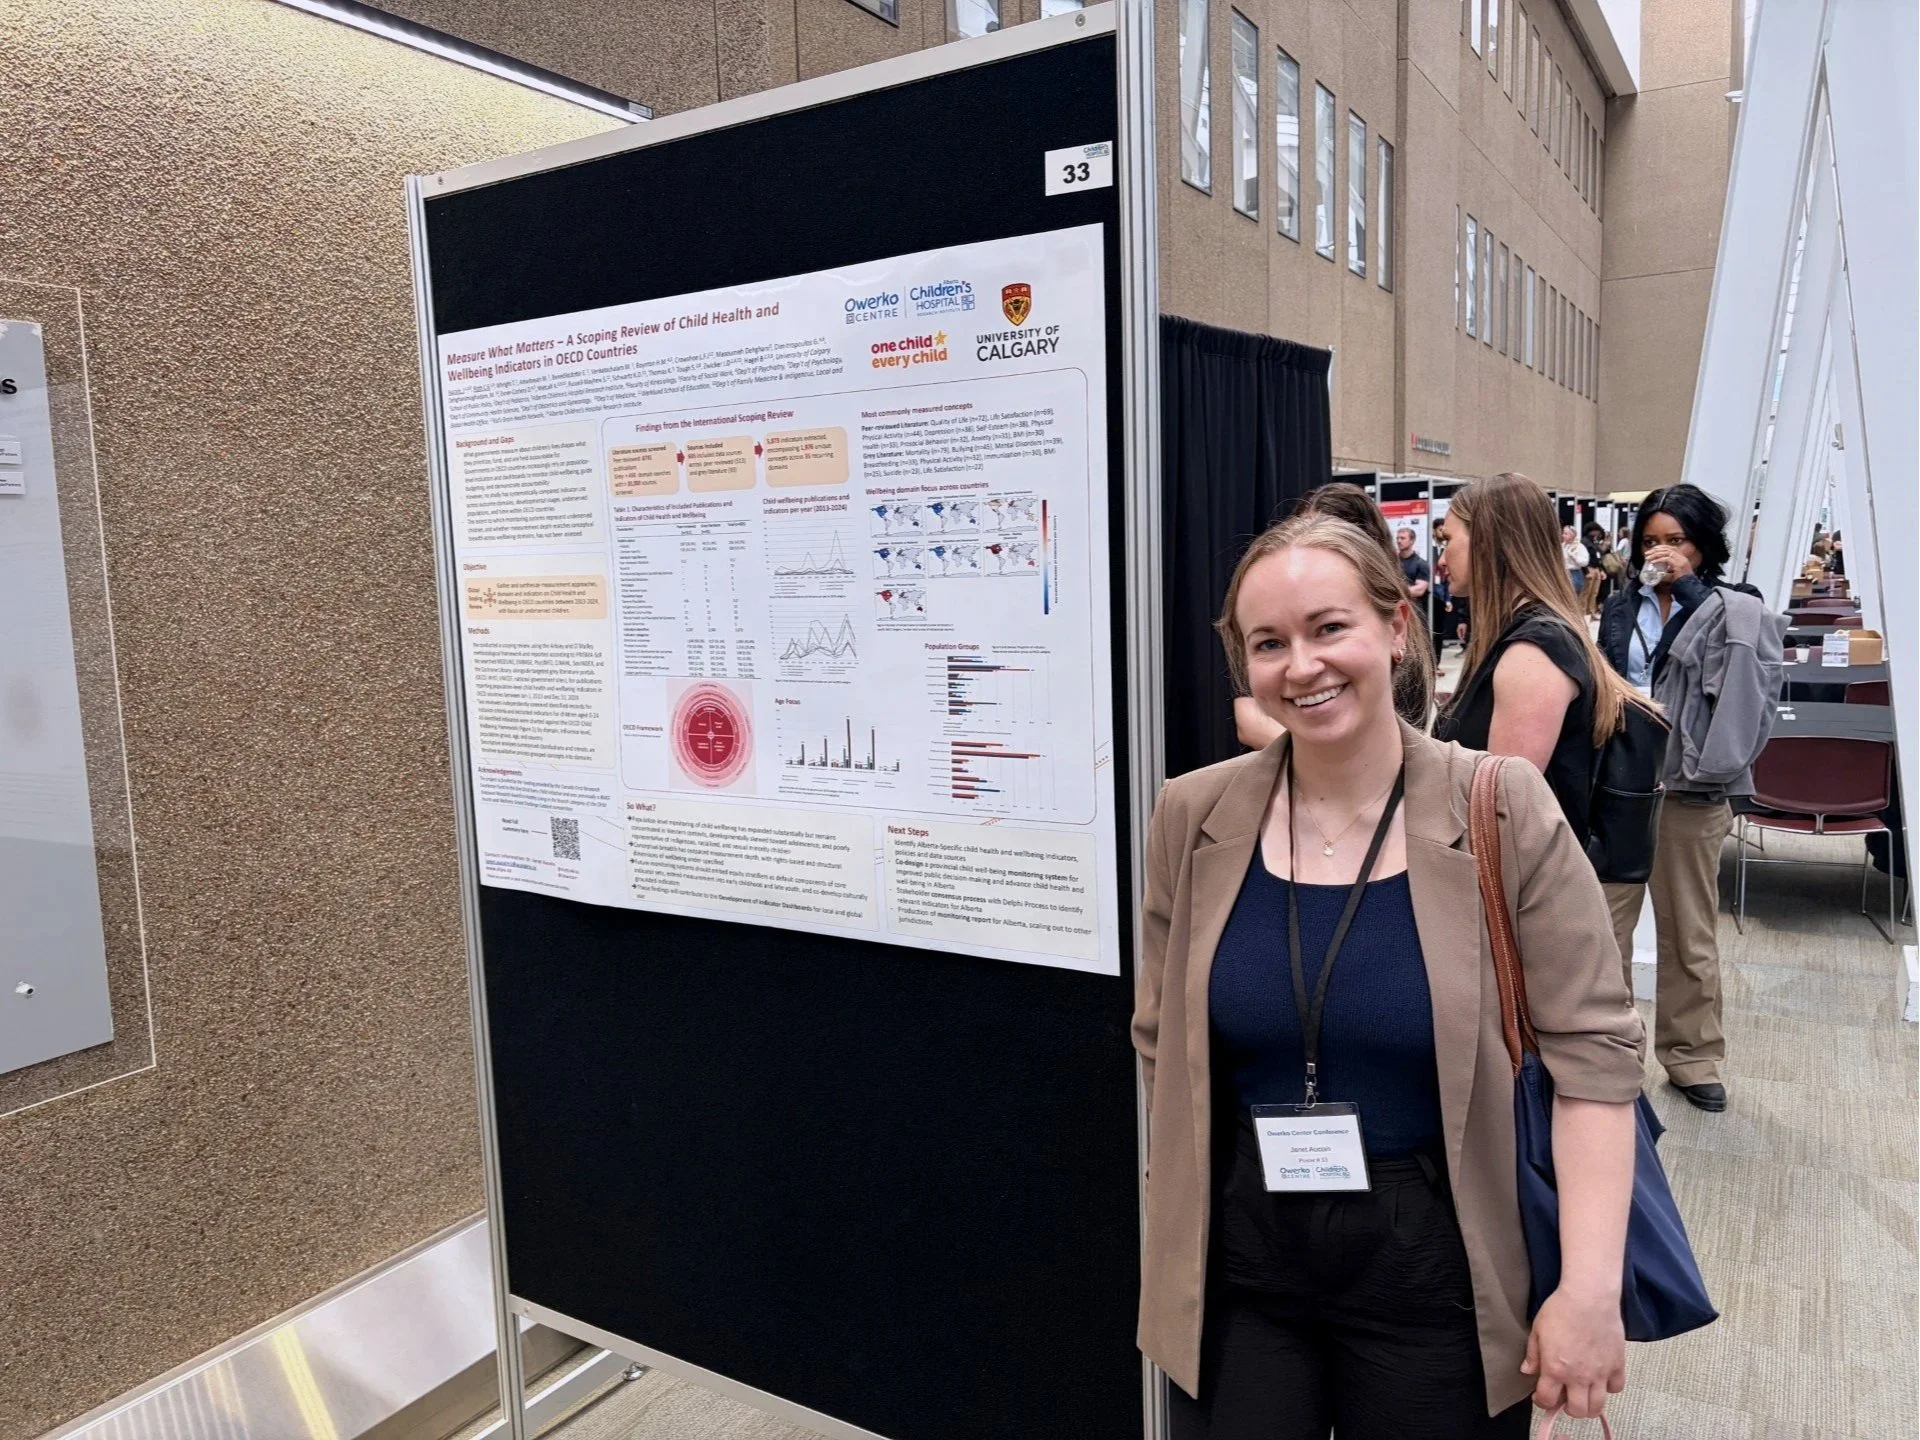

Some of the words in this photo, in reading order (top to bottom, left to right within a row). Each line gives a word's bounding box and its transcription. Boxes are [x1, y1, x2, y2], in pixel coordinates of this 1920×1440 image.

[1062, 162, 1090, 184] 33
[844, 292, 899, 312] Owerko
[910, 281, 972, 300] Children's
[856, 308, 898, 322] CENTRE
[916, 297, 960, 310] HOSPITAL
[447, 351, 485, 365] Measure
[487, 344, 512, 358] What
[515, 339, 554, 354] Matters
[576, 329, 617, 344] Scoping
[620, 322, 660, 337] Review
[663, 317, 675, 331] of
[678, 312, 708, 329] Child
[712, 306, 751, 324] Health
[756, 301, 779, 317] and
[976, 327, 1042, 344] UNIVERSITY
[1045, 325, 1059, 335] OF
[871, 342, 896, 354] one
[900, 335, 932, 351] child
[976, 337, 1059, 362] CALGARY
[447, 365, 493, 381] Wellbeing
[494, 359, 541, 374] Indicators
[543, 355, 553, 366] in
[555, 350, 583, 365] OECD
[586, 343, 637, 360] Countries
[872, 353, 910, 368] every
[913, 348, 947, 364] child
[878, 407, 910, 416] commonly
[911, 404, 943, 413] measured
[943, 402, 972, 410] concepts
[635, 423, 661, 432] Findings
[662, 421, 679, 429] from
[680, 419, 691, 428] the
[692, 414, 737, 426] International
[737, 412, 766, 423] Scoping
[766, 409, 793, 419] Review
[455, 438, 488, 448] Background
[803, 495, 838, 503] publications
[463, 563, 486, 571] Objective
[477, 766, 522, 776] Acknowledgements
[635, 802, 656, 811] What?
[887, 825, 905, 834] Next
[907, 827, 928, 837] Steps
[894, 858, 924, 868] Co-design
[1007, 870, 1043, 880] monitoring
[896, 886, 930, 896] Stakeholder
[930, 892, 962, 900] consensus
[1002, 898, 1022, 907] Delphi
[1024, 900, 1048, 909] Process
